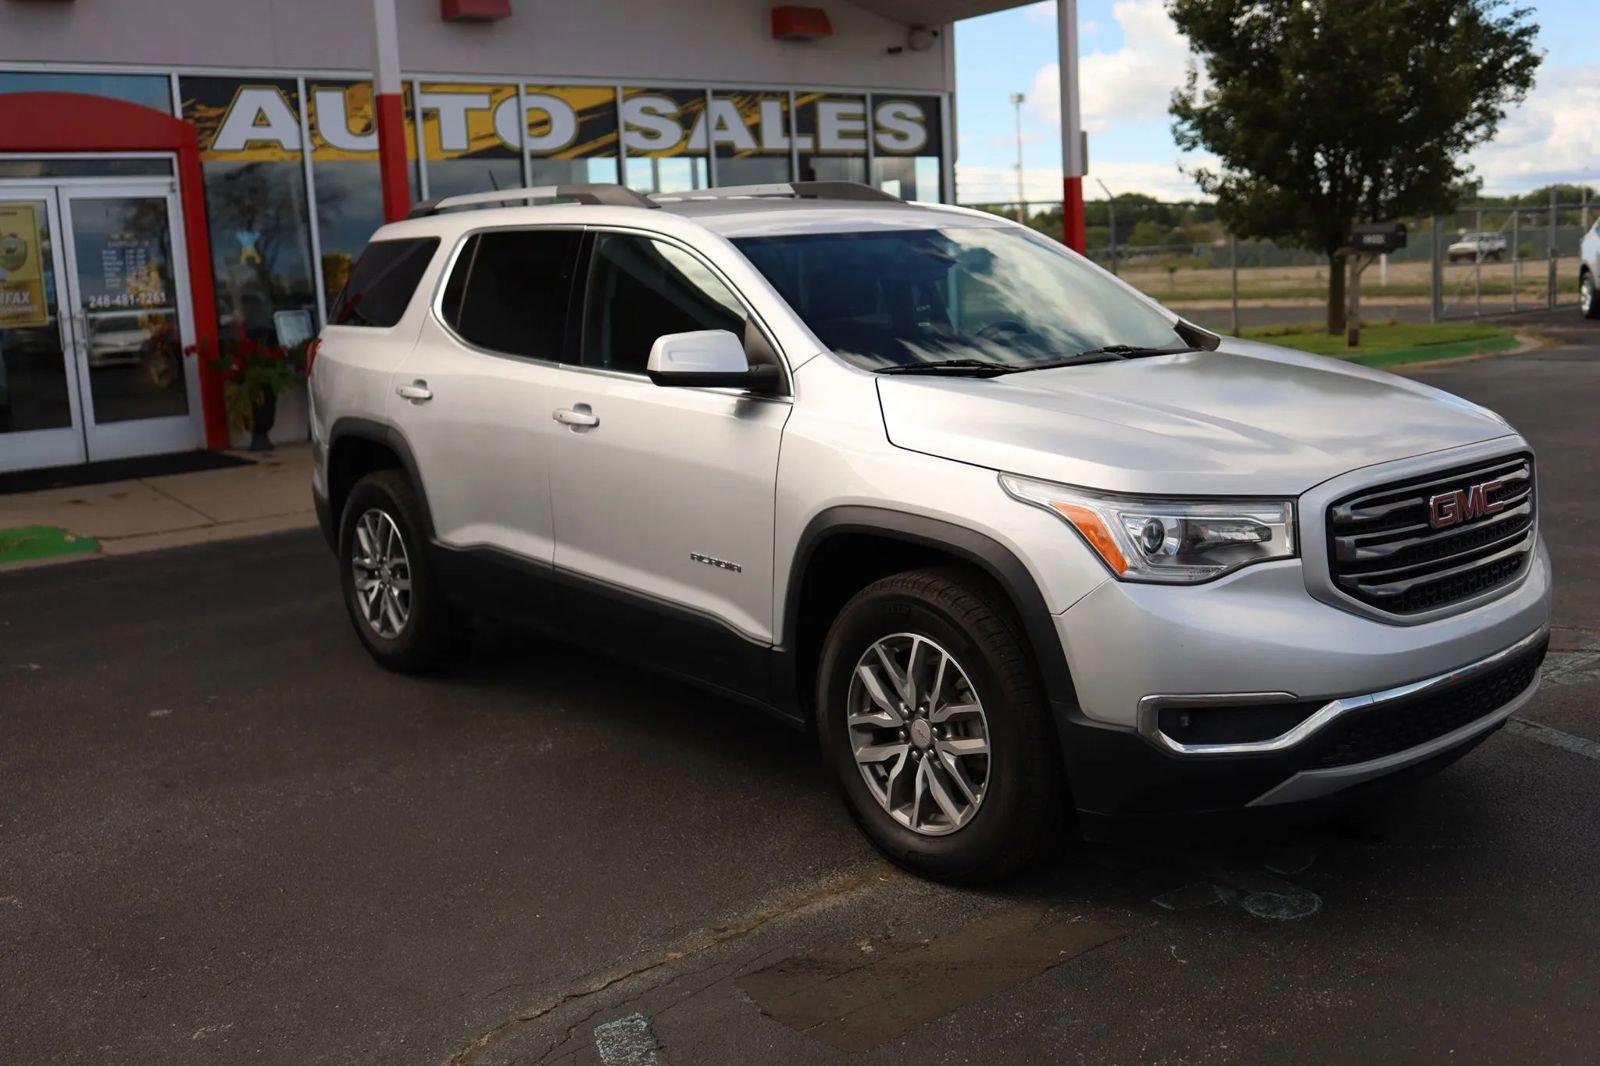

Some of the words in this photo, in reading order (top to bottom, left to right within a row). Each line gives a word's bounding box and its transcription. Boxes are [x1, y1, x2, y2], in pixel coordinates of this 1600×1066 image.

[210, 85, 579, 152] AUTO
[622, 96, 928, 151] SALES
[1430, 479, 1504, 529] GMC
